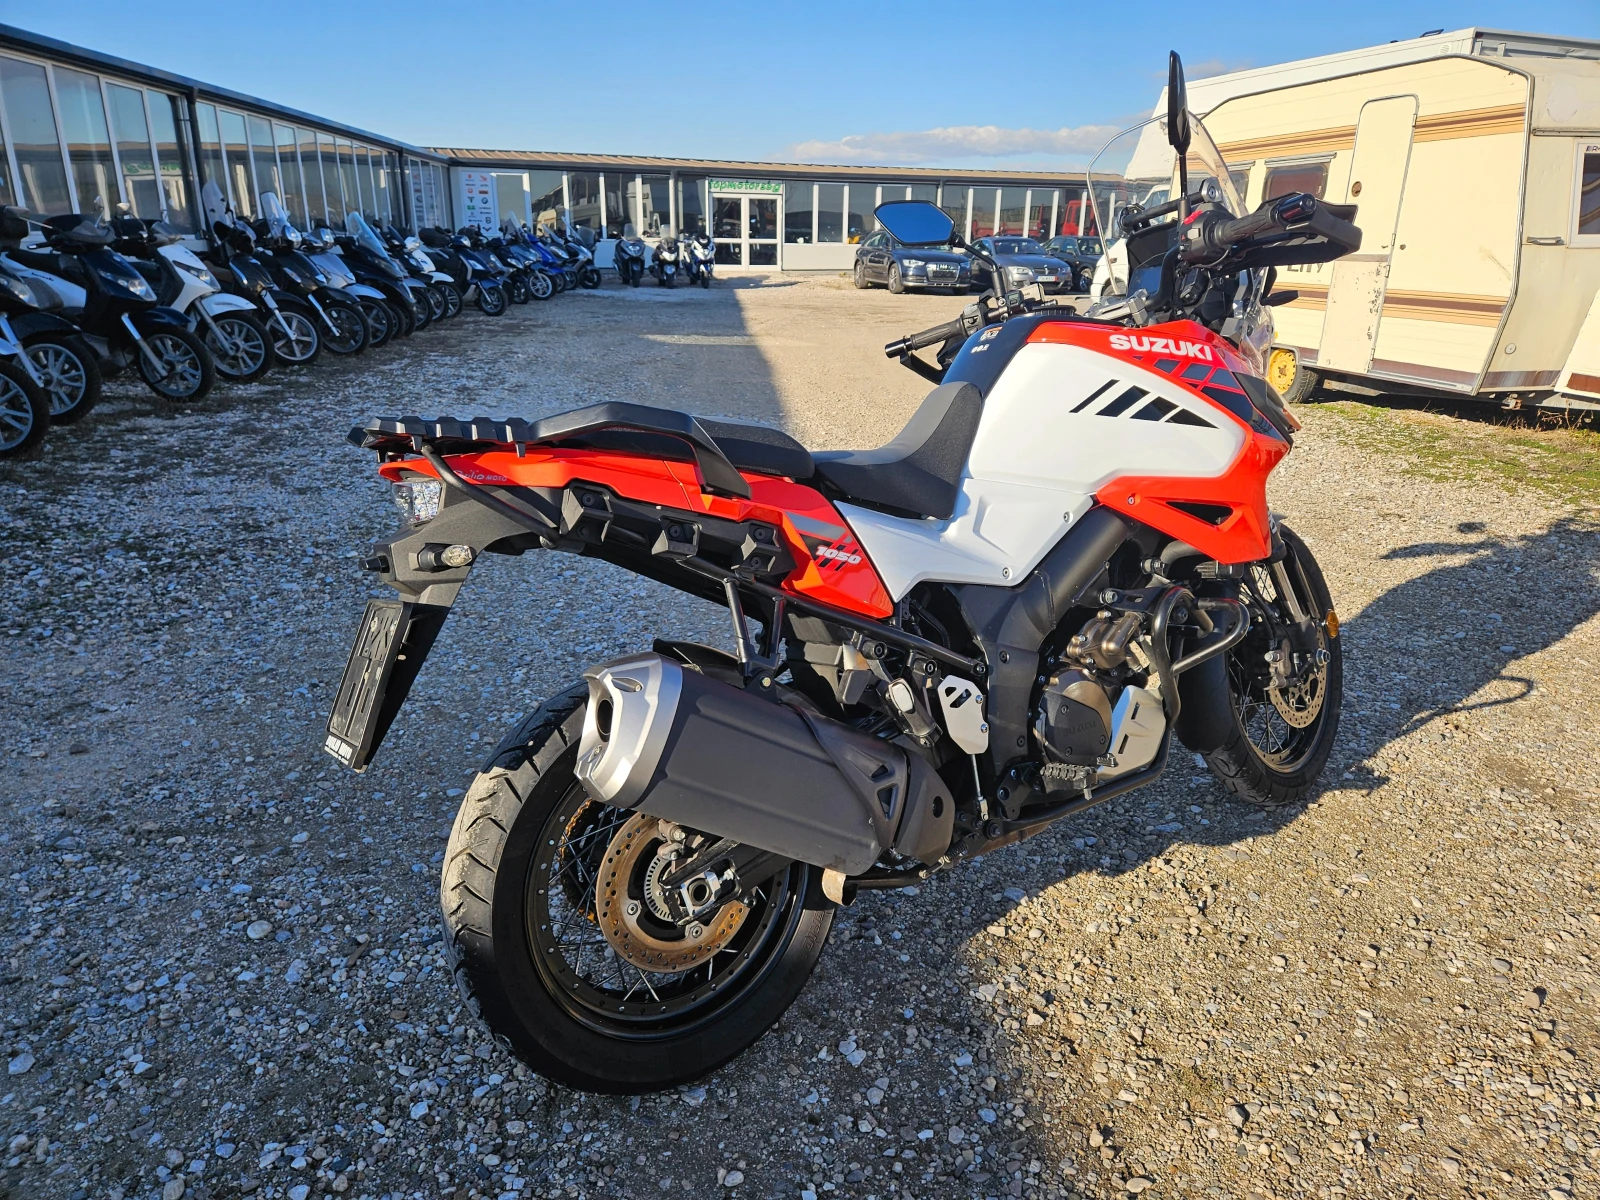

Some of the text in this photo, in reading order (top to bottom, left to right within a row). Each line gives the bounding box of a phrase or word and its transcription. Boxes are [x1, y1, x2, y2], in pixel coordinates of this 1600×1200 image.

[709, 179, 780, 192] topmotorsbg
[1109, 334, 1213, 361] SUZUKI
[486, 474, 507, 482] MOTO
[815, 545, 862, 564] 1050
